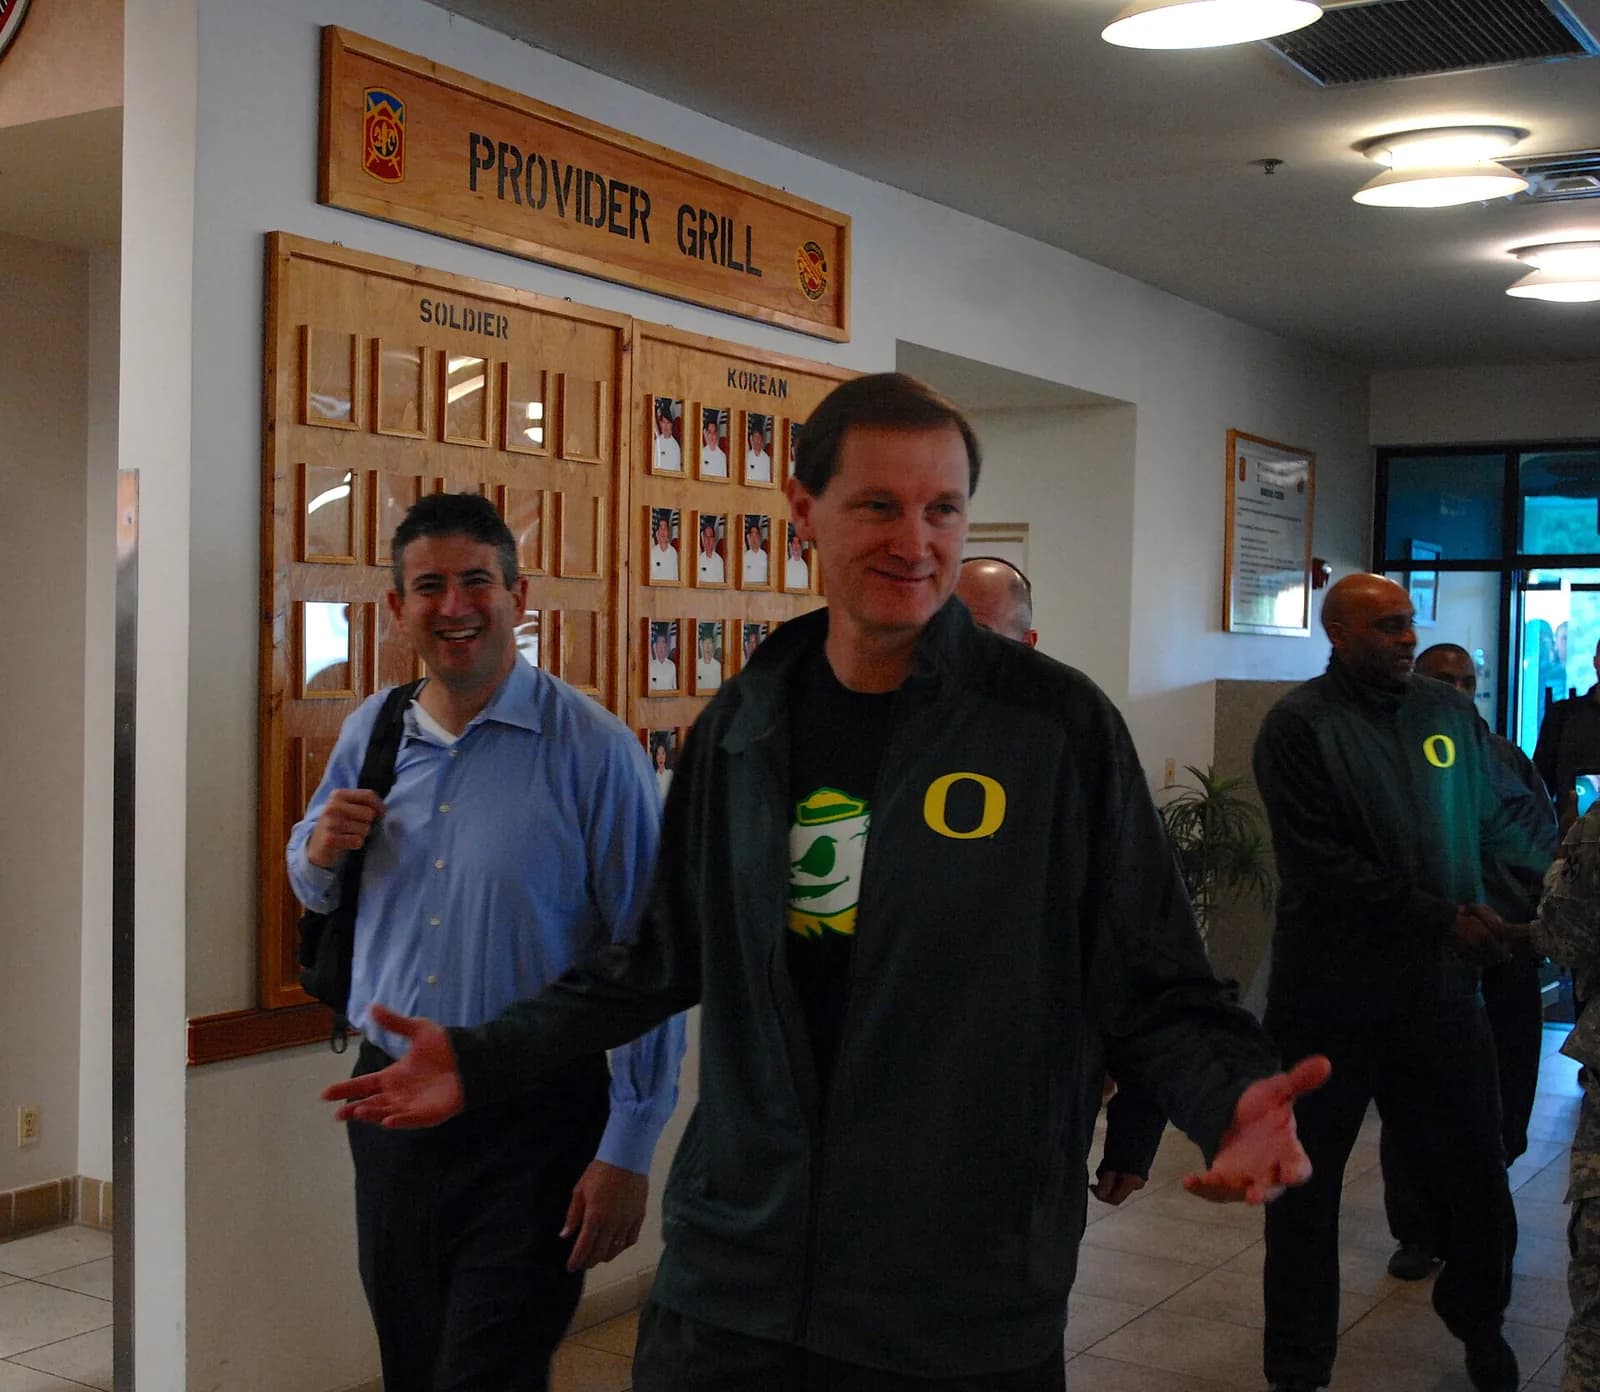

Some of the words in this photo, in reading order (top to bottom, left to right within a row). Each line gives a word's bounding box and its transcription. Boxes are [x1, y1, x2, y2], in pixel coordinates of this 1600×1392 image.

[469, 132, 650, 243] PROVIDER
[677, 204, 762, 277] GRILL
[420, 299, 508, 339] SOLDIER
[727, 367, 787, 398] KOREAN
[1422, 734, 1455, 768] O
[923, 772, 1006, 839] O
